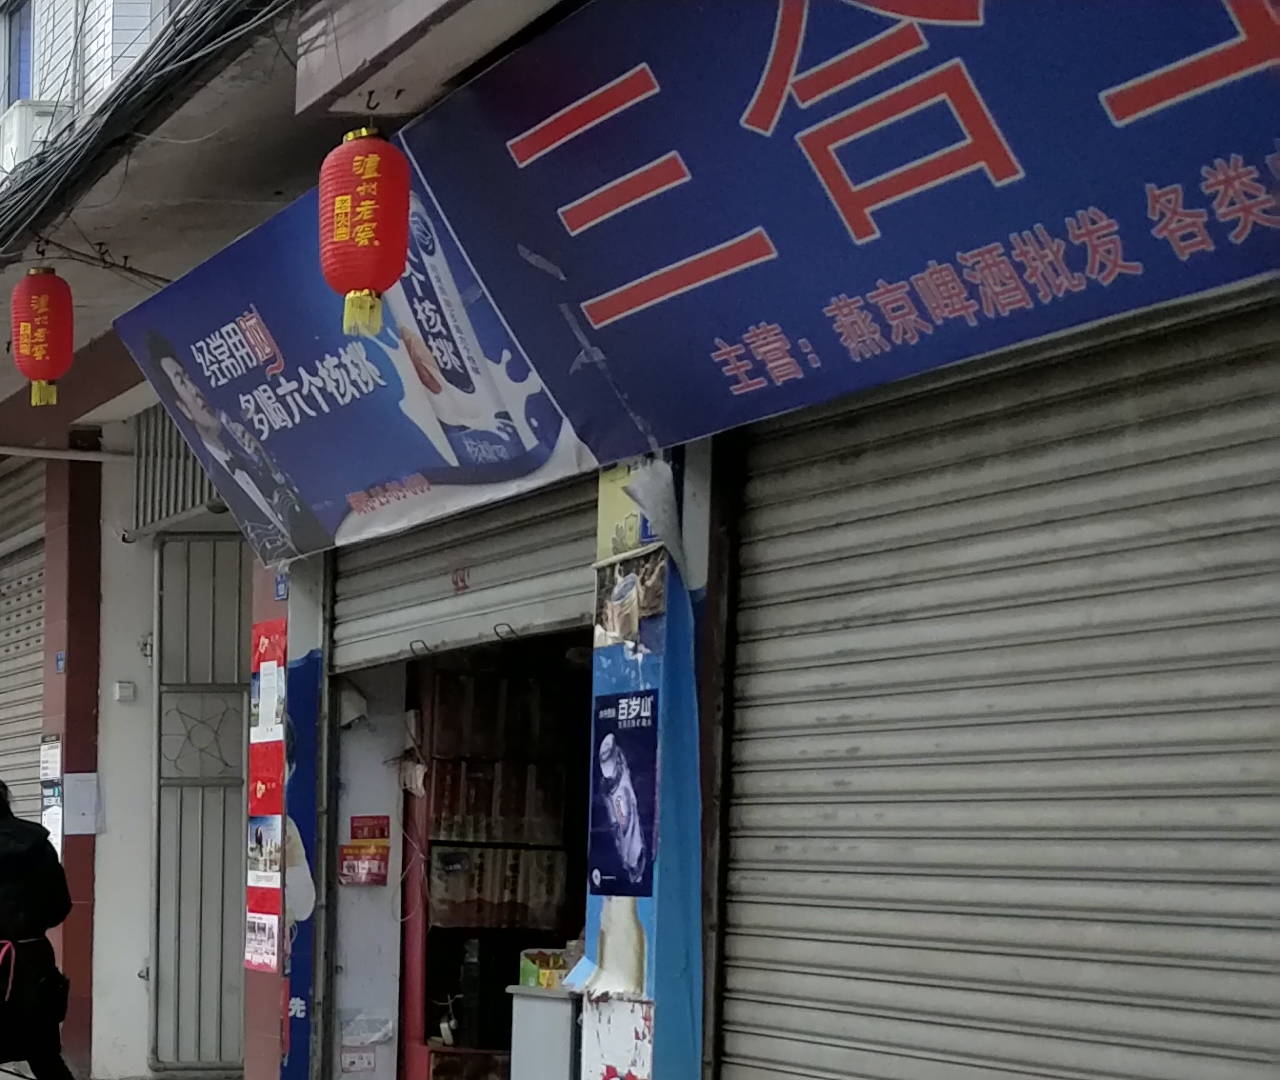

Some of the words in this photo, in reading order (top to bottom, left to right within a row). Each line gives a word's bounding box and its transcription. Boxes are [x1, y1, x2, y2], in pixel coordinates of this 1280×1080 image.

[1145, 138, 1280, 261] 各类
[405, 247, 465, 374] 个核桃
[239, 341, 387, 441] 多喝六个核桃
[618, 697, 653, 721] 百岁山
